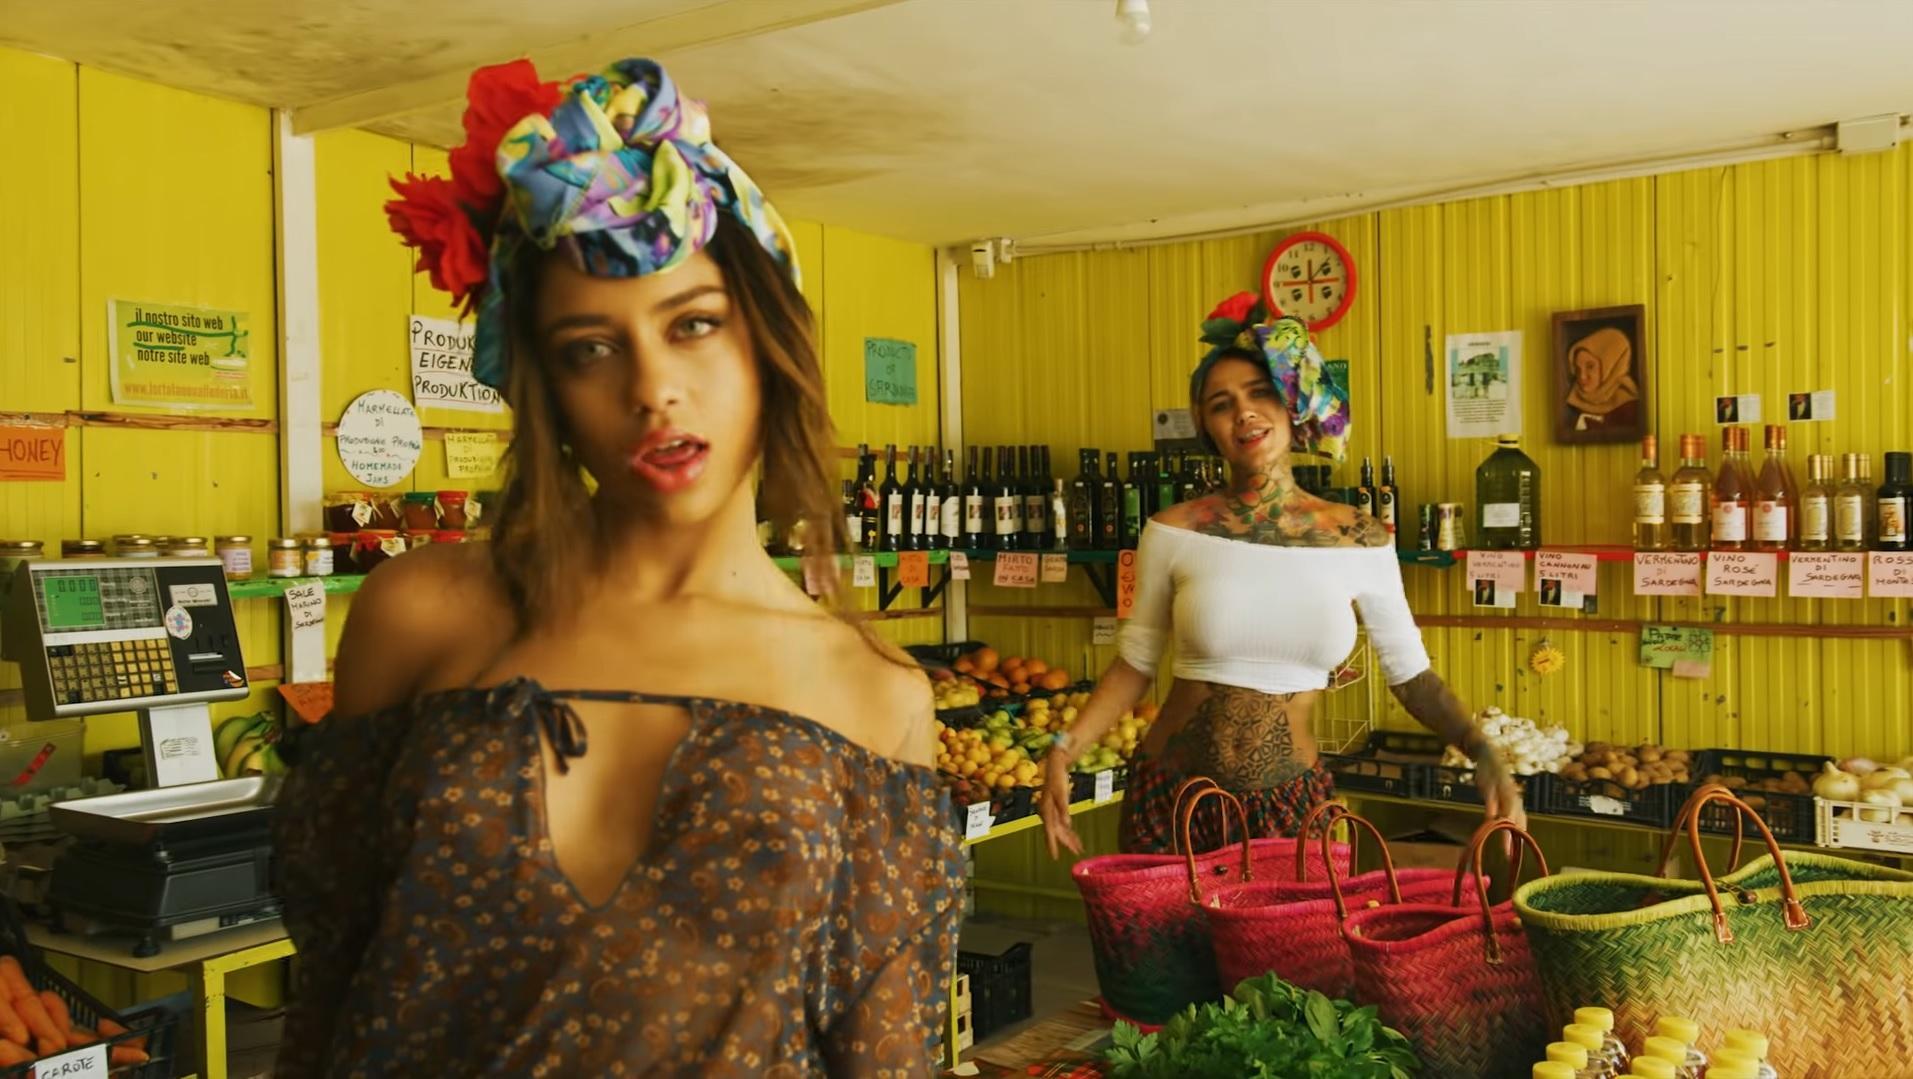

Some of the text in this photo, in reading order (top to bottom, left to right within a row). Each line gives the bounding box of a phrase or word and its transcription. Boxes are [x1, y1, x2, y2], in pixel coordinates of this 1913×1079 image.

[135, 308, 224, 330] il nostro sito web
[136, 330, 197, 346] our website
[137, 350, 210, 366] notre site web
[1539, 552, 1562, 560] VINO
[1635, 554, 1699, 566] VERMENTINO
[1712, 554, 1746, 564] VINO
[1791, 554, 1857, 564] VERMENTINO
[1815, 564, 1827, 572] DI
